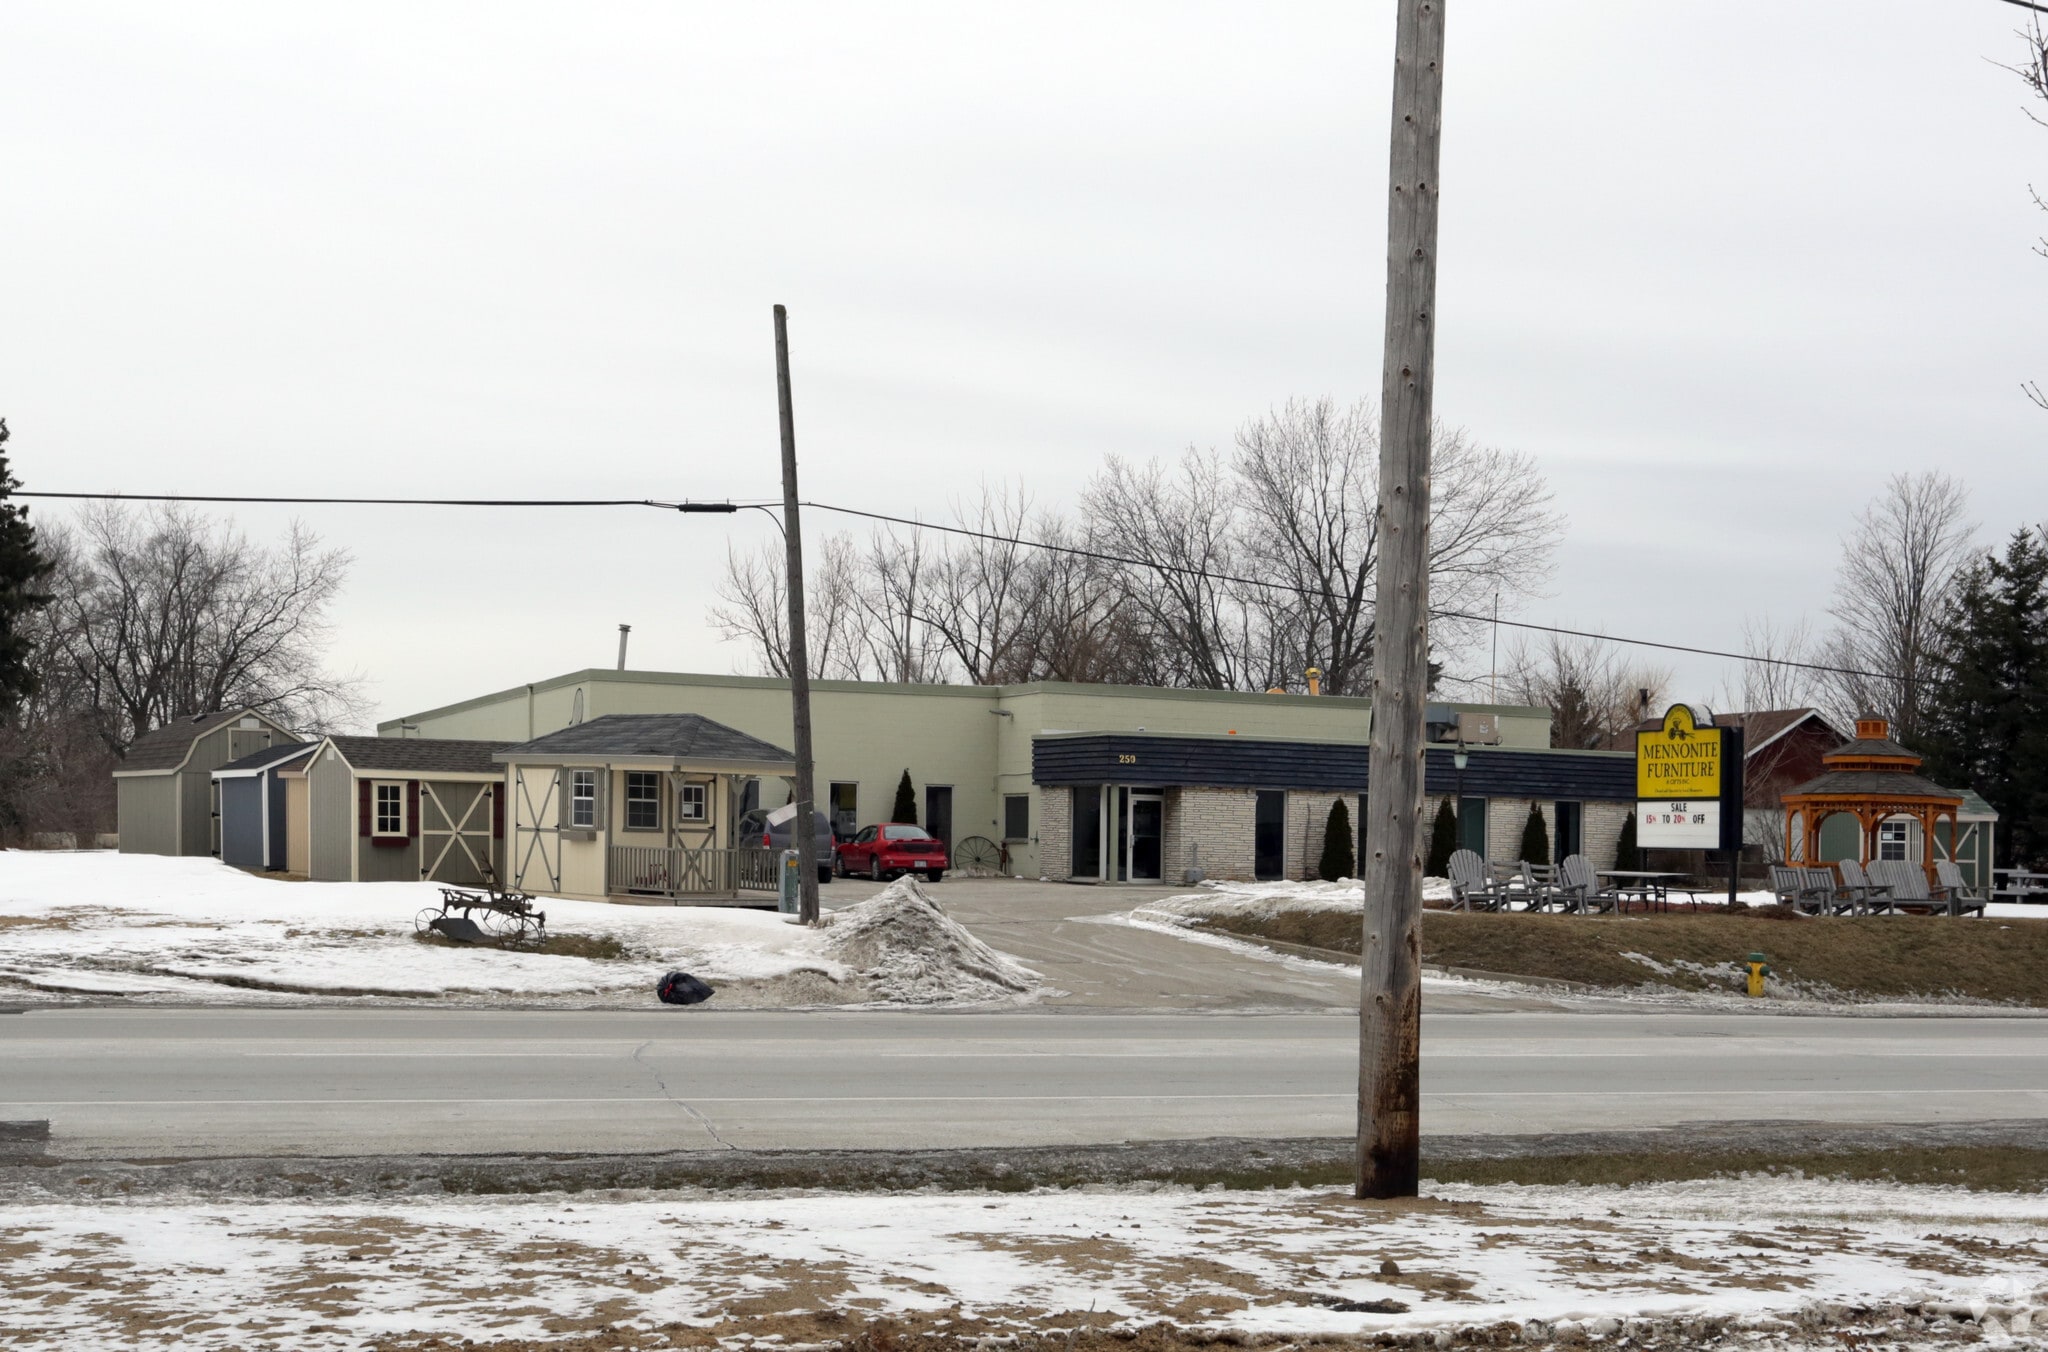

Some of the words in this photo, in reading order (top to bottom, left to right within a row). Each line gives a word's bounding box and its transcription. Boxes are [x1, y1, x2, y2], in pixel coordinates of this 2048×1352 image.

[1643, 742, 1718, 760] MENNONITE
[1647, 761, 1715, 778] FURNITURE
[1671, 803, 1687, 812] SALE
[1662, 814, 1670, 824] TO
[1692, 814, 1705, 824] OFF
